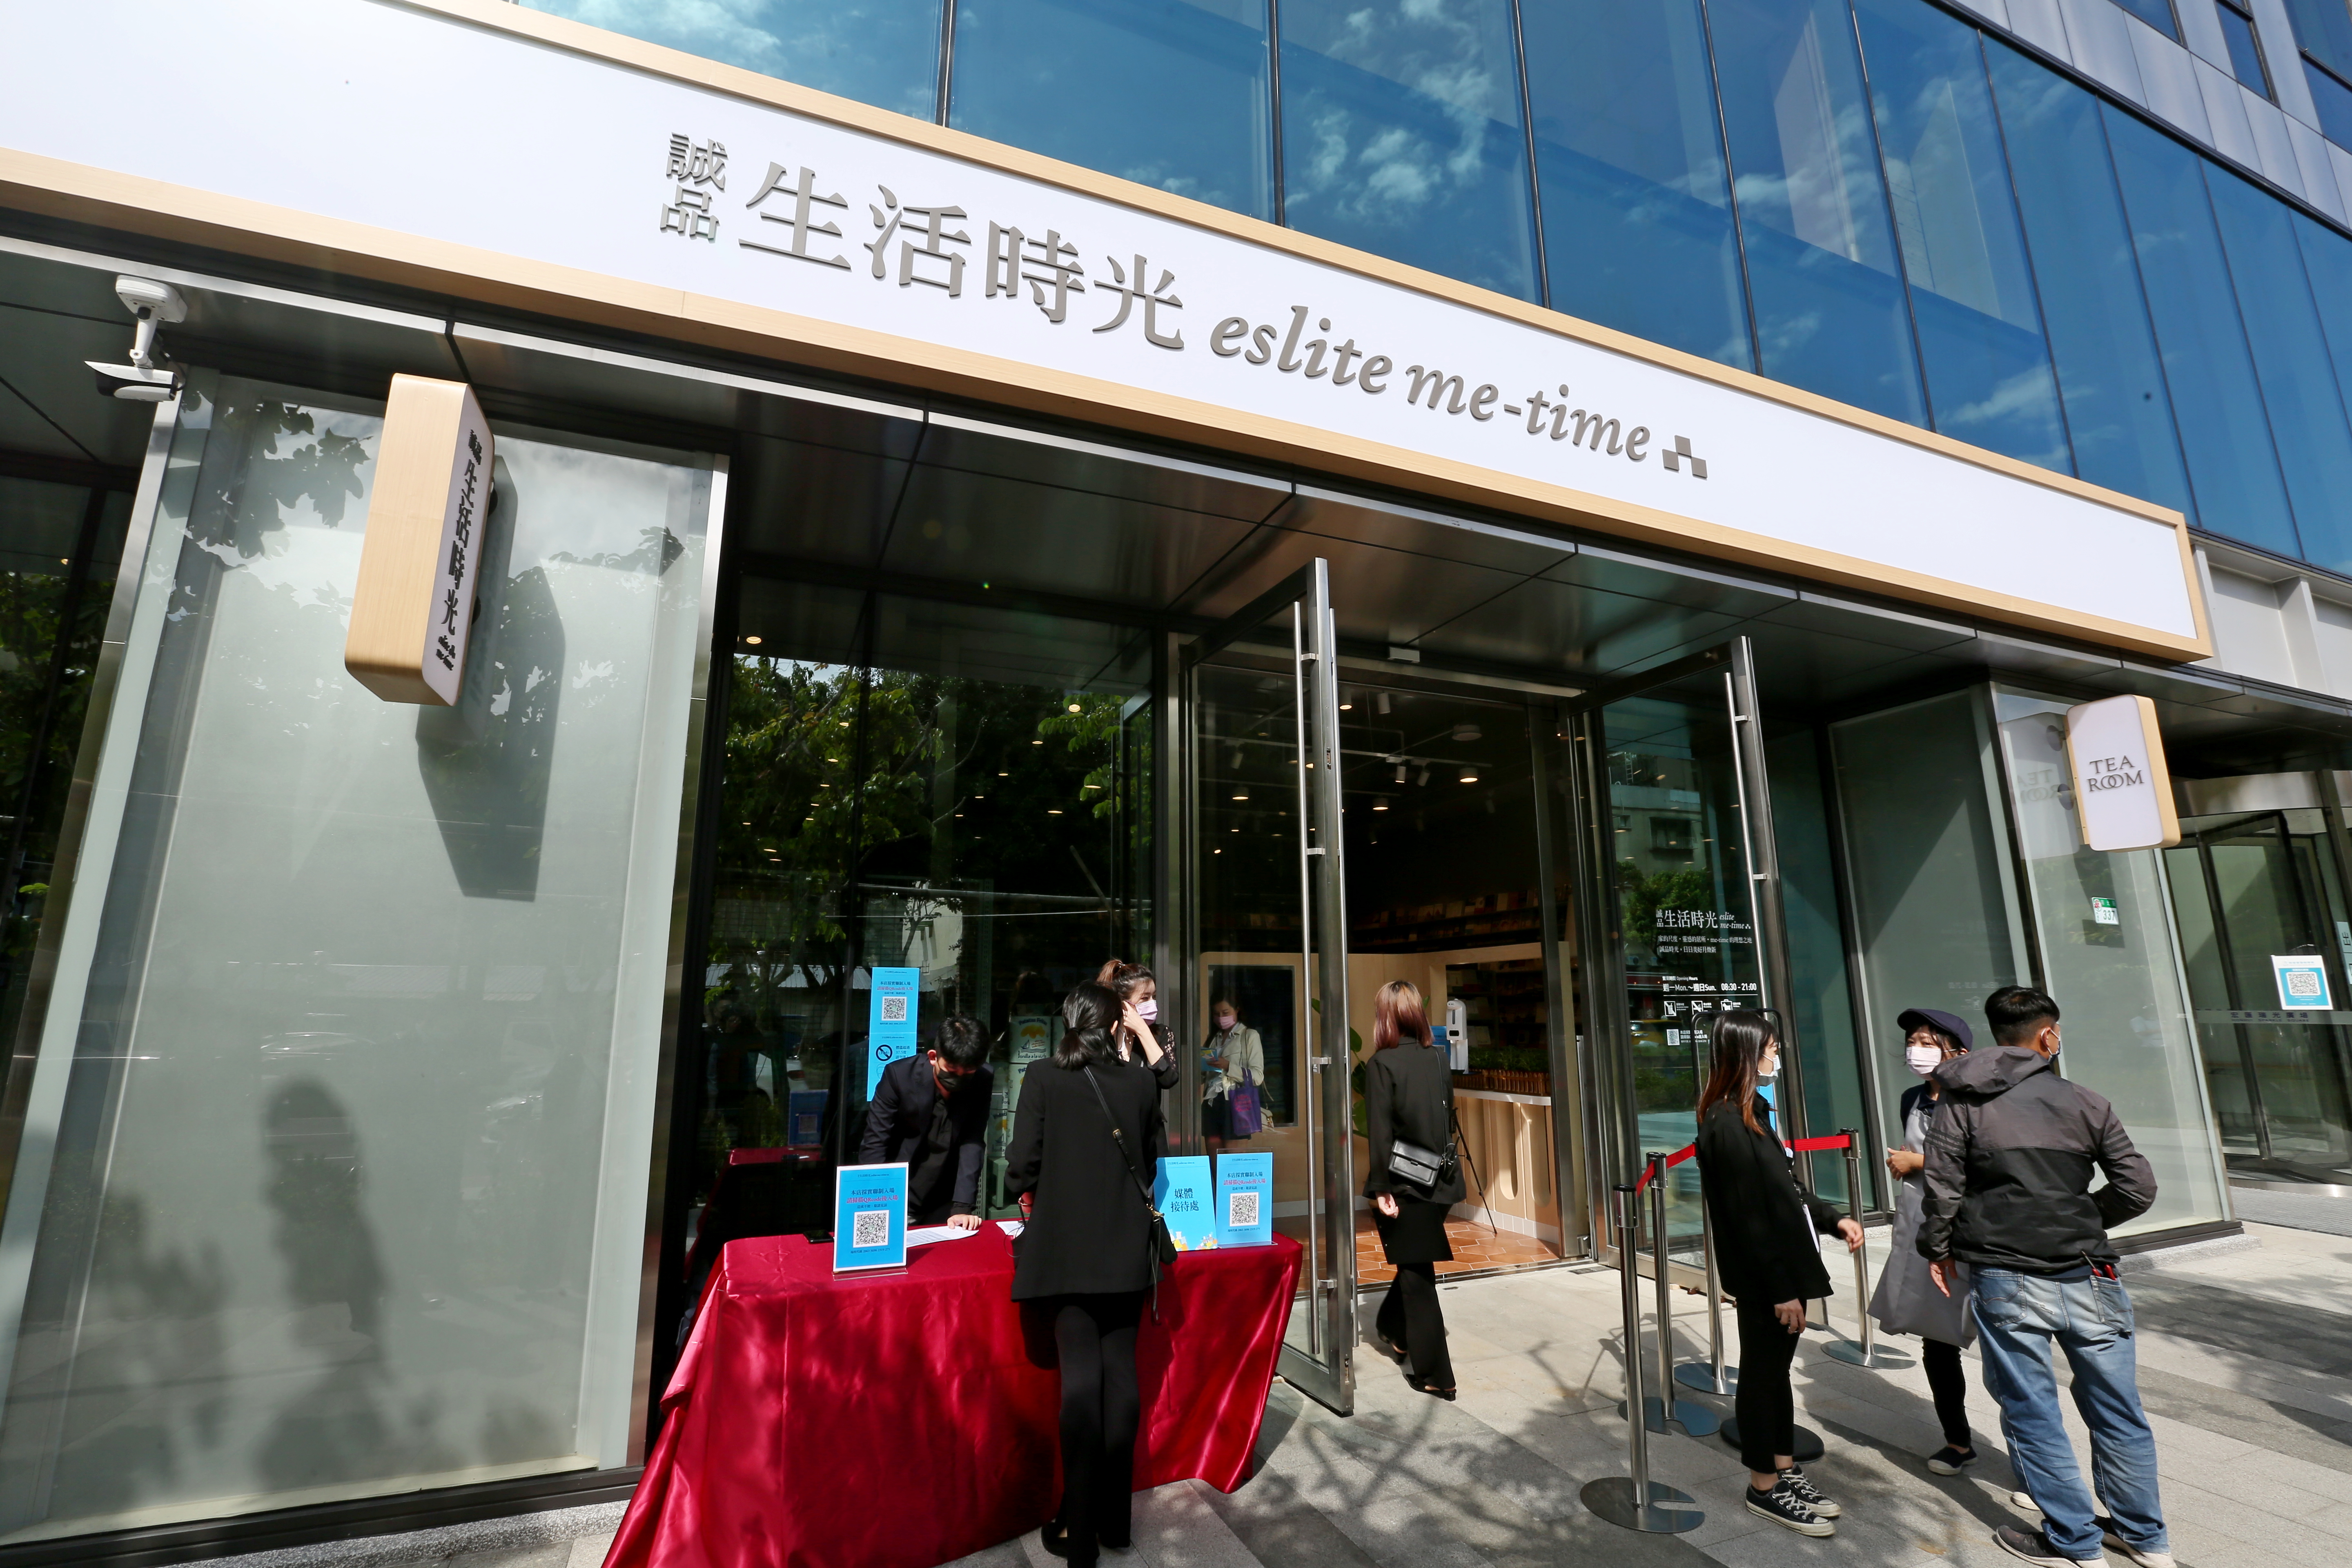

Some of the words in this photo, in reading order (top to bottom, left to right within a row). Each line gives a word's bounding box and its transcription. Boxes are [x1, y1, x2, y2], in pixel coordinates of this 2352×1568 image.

[660, 131, 728, 243] 誠品
[738, 160, 1185, 351] 生活時光
[1210, 305, 1393, 394] eslite
[1406, 363, 1651, 462] me-time
[441, 459, 477, 636] 生活時光
[2089, 755, 2135, 774] TEA
[2086, 769, 2145, 792] ROOM
[1656, 909, 1664, 927] 誠品
[1664, 910, 1718, 929] 生活時光
[1719, 911, 1735, 920] eslite
[2103, 910, 2115, 921] 337
[1018, 1050, 1031, 1058] Bonilla
[851, 1187, 895, 1196] 本店採實聯制入場
[1174, 1187, 1194, 1199] 媒體
[846, 1195, 898, 1204] 請掃描QRcode後入場
[1170, 1200, 1200, 1213] 接待處
